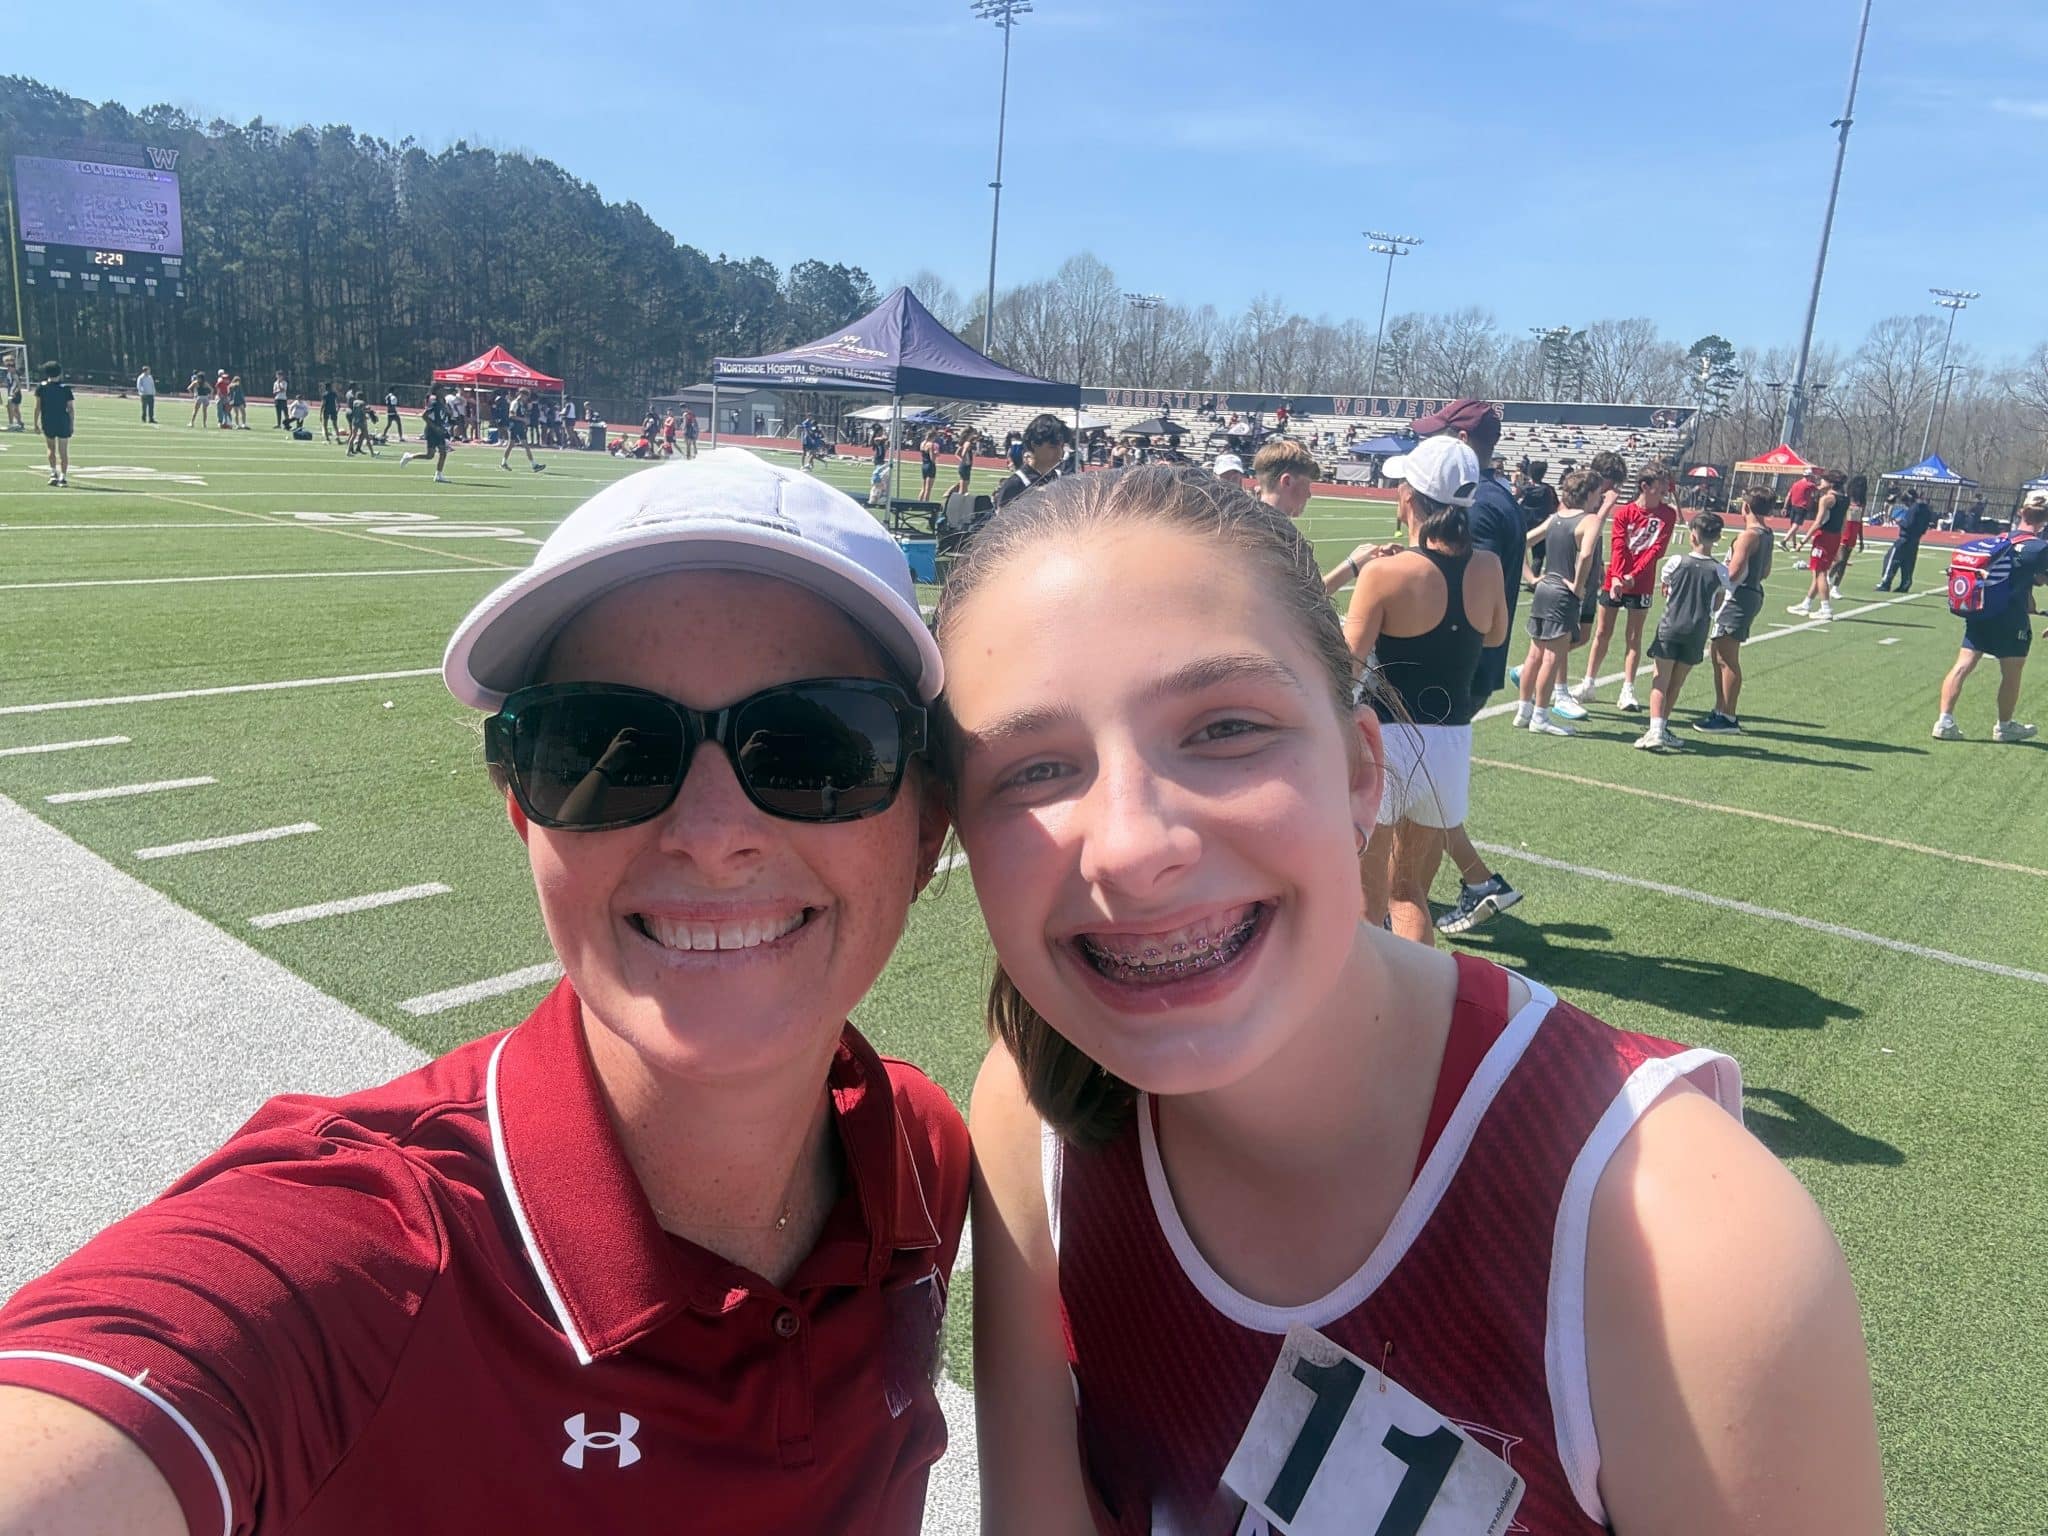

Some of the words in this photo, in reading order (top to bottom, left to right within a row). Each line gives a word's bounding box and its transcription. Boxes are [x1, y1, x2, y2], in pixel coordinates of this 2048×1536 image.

[147, 147, 179, 170] W
[95, 251, 124, 266] 2:29
[719, 362, 766, 374] NORTHSIDE
[767, 363, 808, 375] HOSPITAL
[809, 364, 844, 377] SPORTS
[1105, 389, 1230, 411] WOODSTOCK
[1333, 398, 1504, 420] WOLVERS
[1648, 520, 1659, 534] 8
